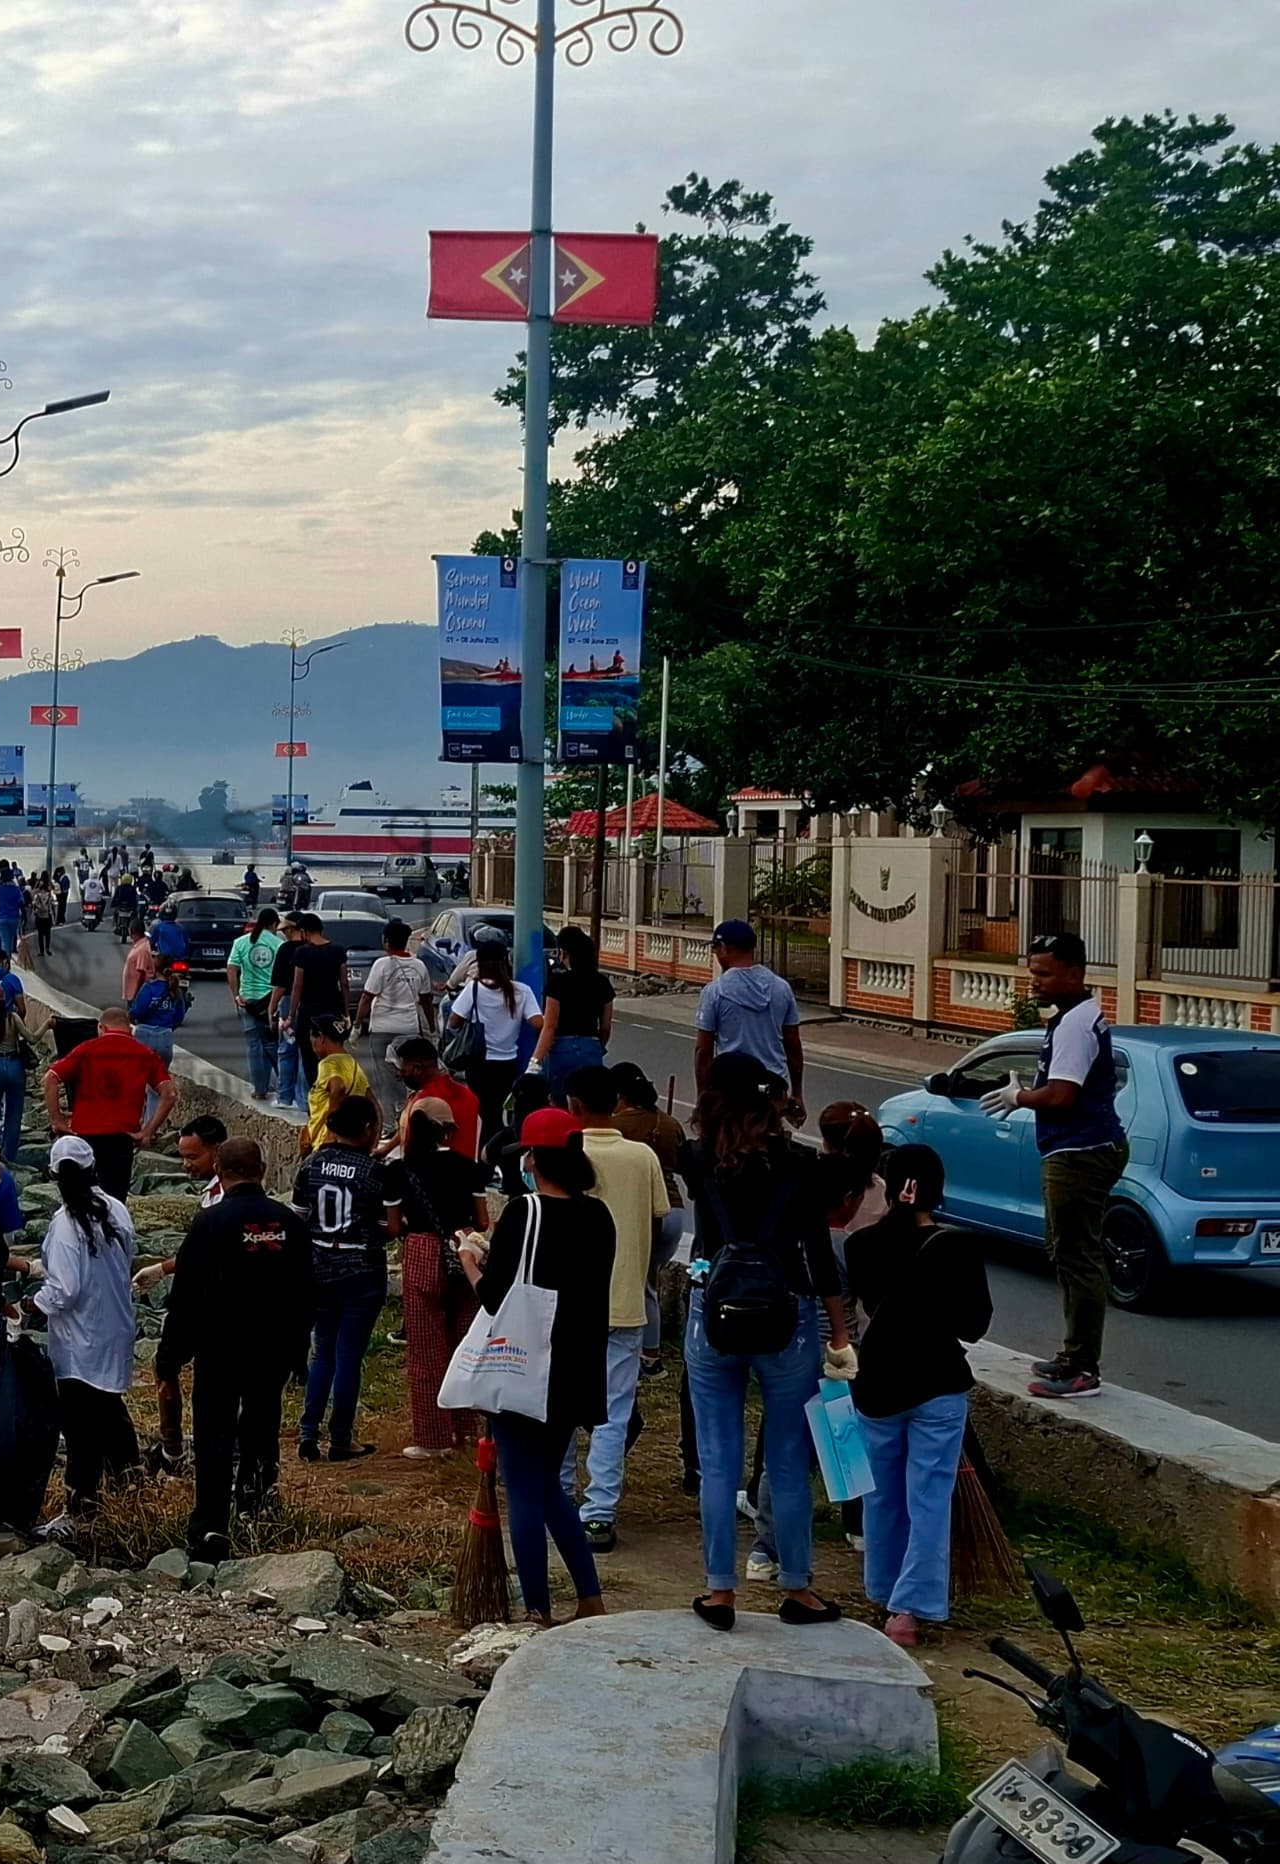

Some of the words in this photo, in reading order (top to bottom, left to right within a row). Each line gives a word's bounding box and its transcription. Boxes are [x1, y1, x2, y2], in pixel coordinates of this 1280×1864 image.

[569, 570, 601, 590] World
[568, 591, 601, 612] Ocean
[567, 612, 597, 633] Week
